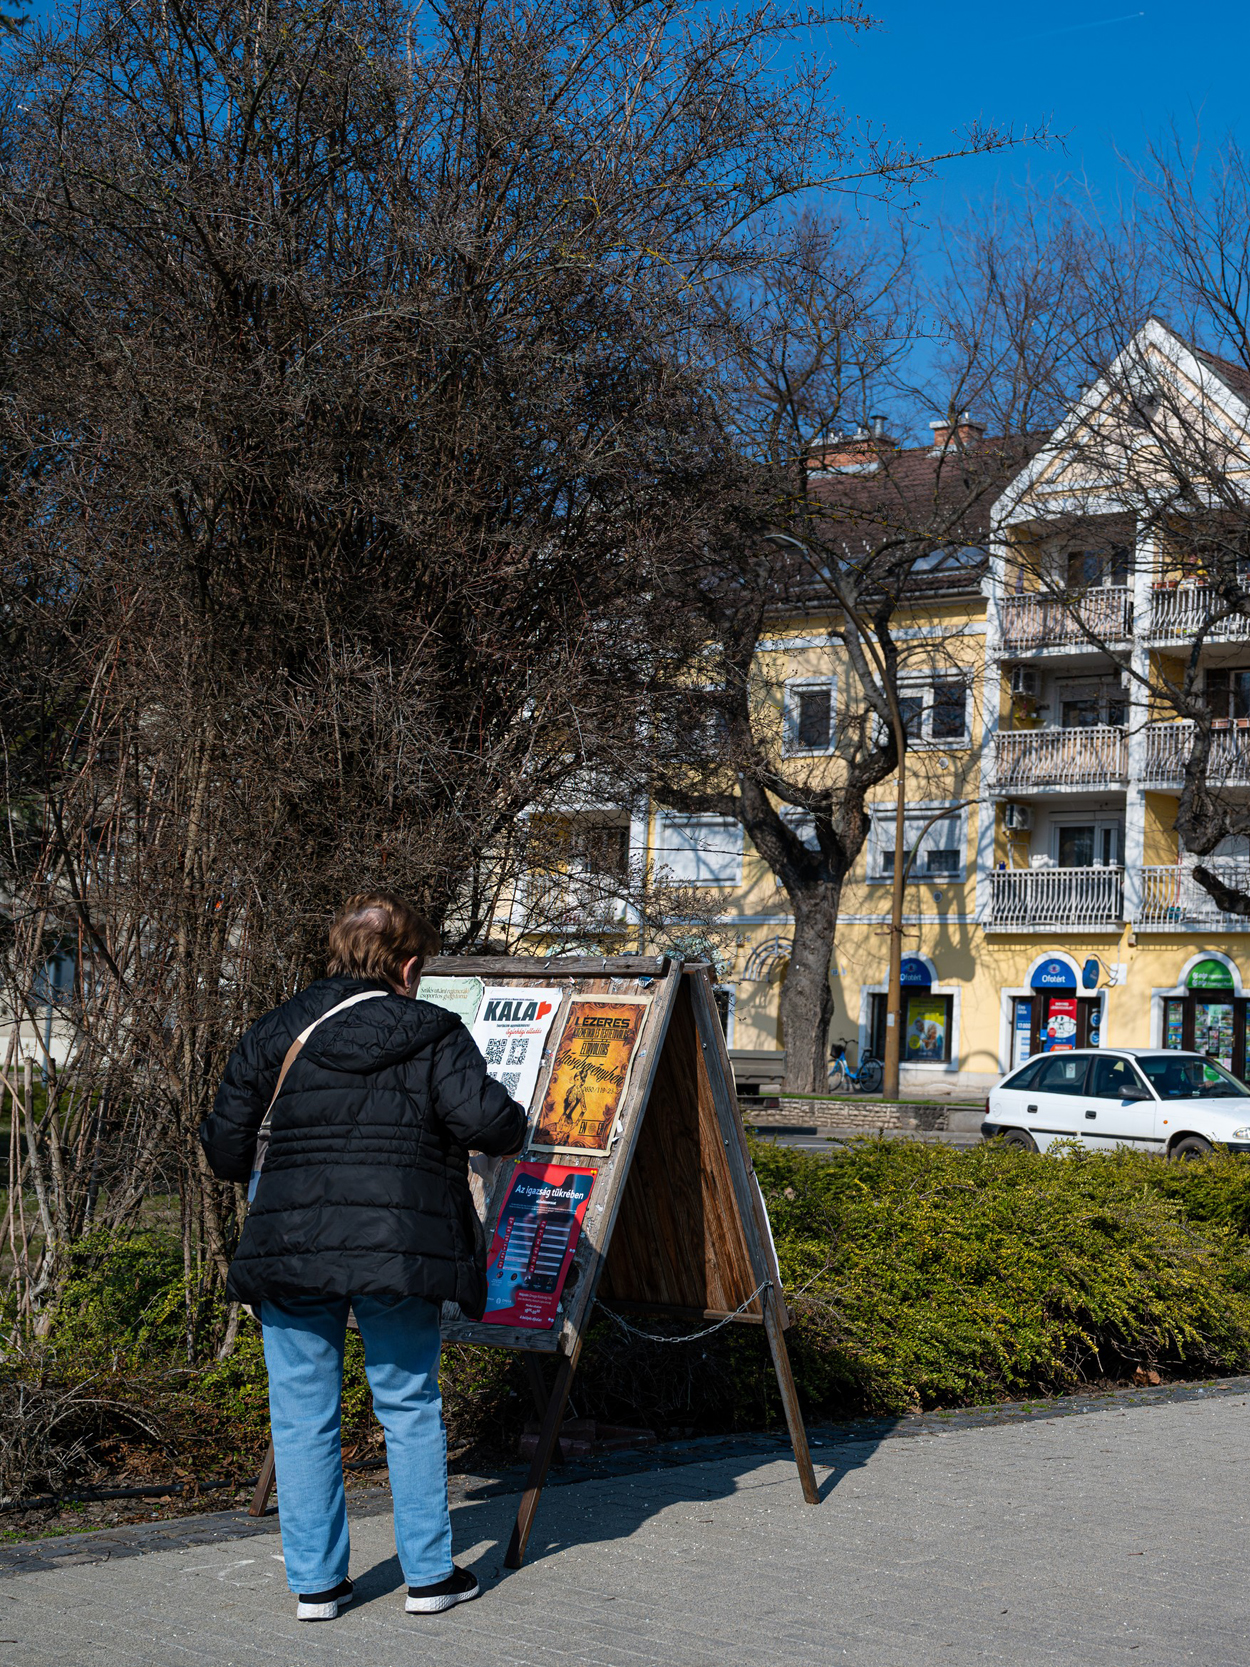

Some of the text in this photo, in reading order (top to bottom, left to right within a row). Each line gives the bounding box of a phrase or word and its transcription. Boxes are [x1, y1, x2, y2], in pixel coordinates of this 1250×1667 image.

[1041, 975, 1066, 983] Ofotért
[575, 1015, 630, 1028] LÉZERES
[515, 1184, 525, 1193] Az
[526, 1186, 551, 1198] igazság
